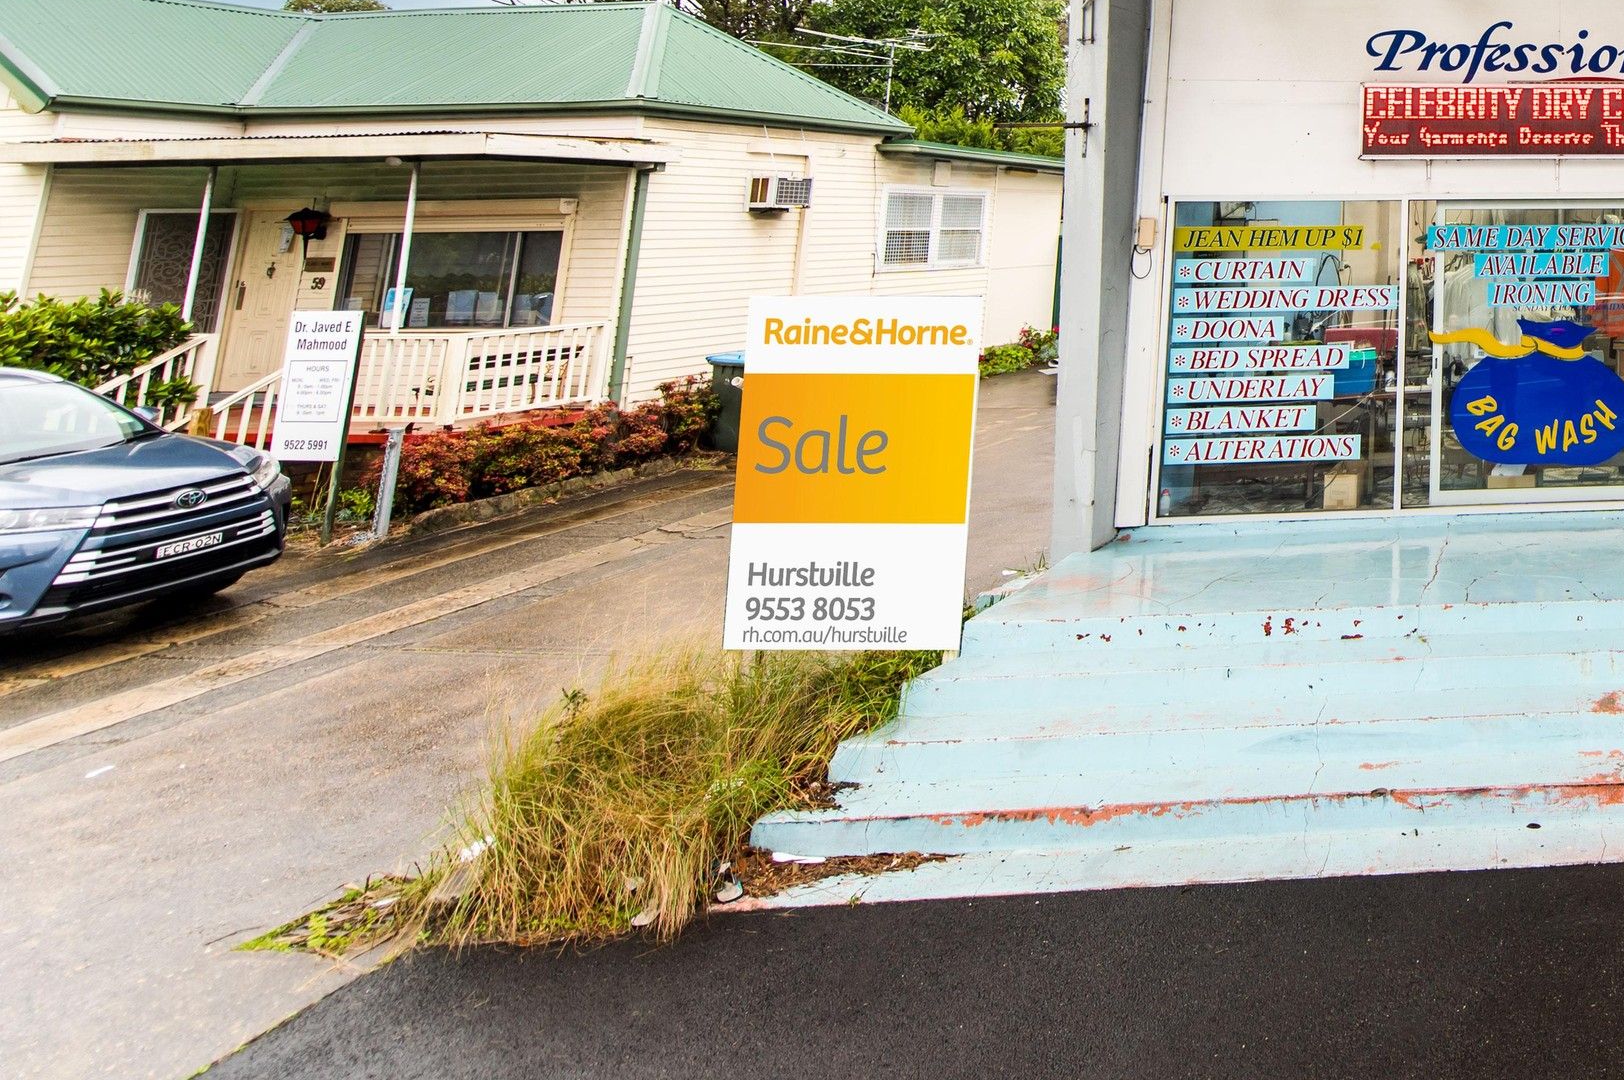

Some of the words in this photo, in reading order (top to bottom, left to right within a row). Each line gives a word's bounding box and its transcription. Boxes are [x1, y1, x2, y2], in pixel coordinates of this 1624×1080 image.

[1365, 87, 1523, 119] CELEBRITY
[1532, 87, 1593, 119] DRY
[1364, 121, 1410, 147] Your
[1519, 126, 1593, 145] Deserve
[1184, 229, 1241, 248] JEAN
[1248, 228, 1300, 247] HEM
[1305, 228, 1336, 246] UP
[1341, 227, 1363, 248] $1
[1433, 226, 1498, 249] SAME
[1507, 226, 1550, 248] DAY
[1195, 260, 1307, 280] CURTAIN
[1479, 254, 1604, 276] AVAILABLE
[310, 277, 326, 290] 59
[1492, 282, 1591, 304] IRONING
[1193, 289, 1309, 310] WEDDING
[1316, 288, 1392, 308] DRESS
[295, 321, 308, 332] Dr.
[311, 321, 342, 333] Javed
[345, 321, 354, 333] E.
[1191, 320, 1277, 339] DOONA
[296, 338, 348, 350] Mahmood
[1190, 350, 1239, 369] BED
[1246, 348, 1344, 368] SPREAD
[1188, 378, 1326, 400] UNDERLAY
[1185, 409, 1307, 430] BLANKET
[1466, 394, 1519, 451] BAG
[1534, 398, 1618, 455] WASH
[284, 440, 305, 450] 9522
[307, 440, 328, 450] 5991
[754, 414, 889, 475] Sale
[1184, 437, 1354, 461] ALTERATIONS
[747, 561, 876, 587] Hurstville
[745, 597, 806, 621] 9553
[812, 597, 876, 621] 8053
[742, 625, 908, 645] rh.com.au/hurstville
